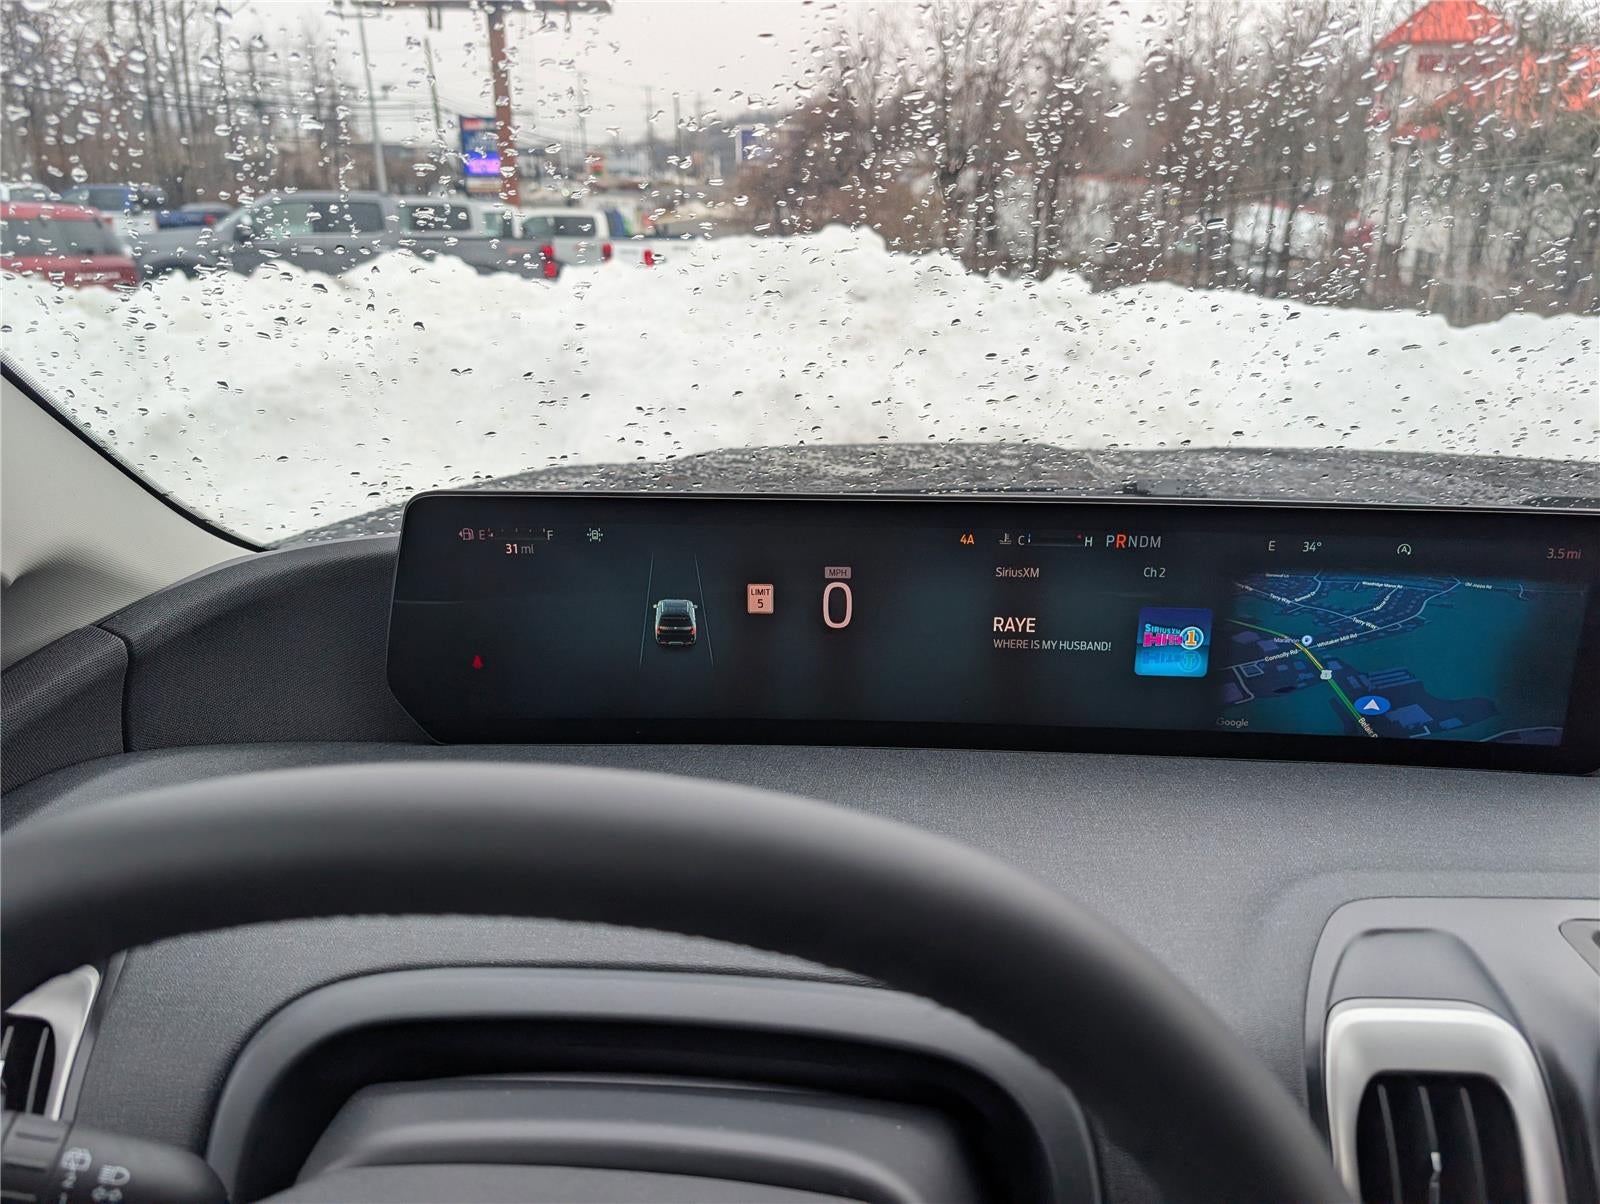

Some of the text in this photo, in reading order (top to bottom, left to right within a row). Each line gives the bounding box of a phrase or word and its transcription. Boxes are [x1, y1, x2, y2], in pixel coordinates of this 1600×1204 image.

[478, 529, 486, 541] E
[547, 529, 554, 541] F
[960, 533, 975, 545] 4A
[1017, 535, 1025, 546] C
[1084, 536, 1093, 547] H
[1268, 540, 1276, 552] E
[1302, 541, 1322, 552] 34°
[505, 543, 534, 554] 31 mi
[1546, 547, 1582, 560] 3.5 mi
[828, 568, 848, 577] MPH
[995, 566, 1040, 578] SiriusXM
[1143, 567, 1166, 578] Ch 2
[750, 588, 771, 596] LIMIT
[757, 598, 764, 609] 5
[822, 581, 853, 629] 0
[993, 616, 1036, 633] RAYE
[993, 638, 1112, 652] WHERE IS MY HUSBAND!
[1264, 651, 1290, 662] Connolly
[1216, 717, 1249, 729] Google
